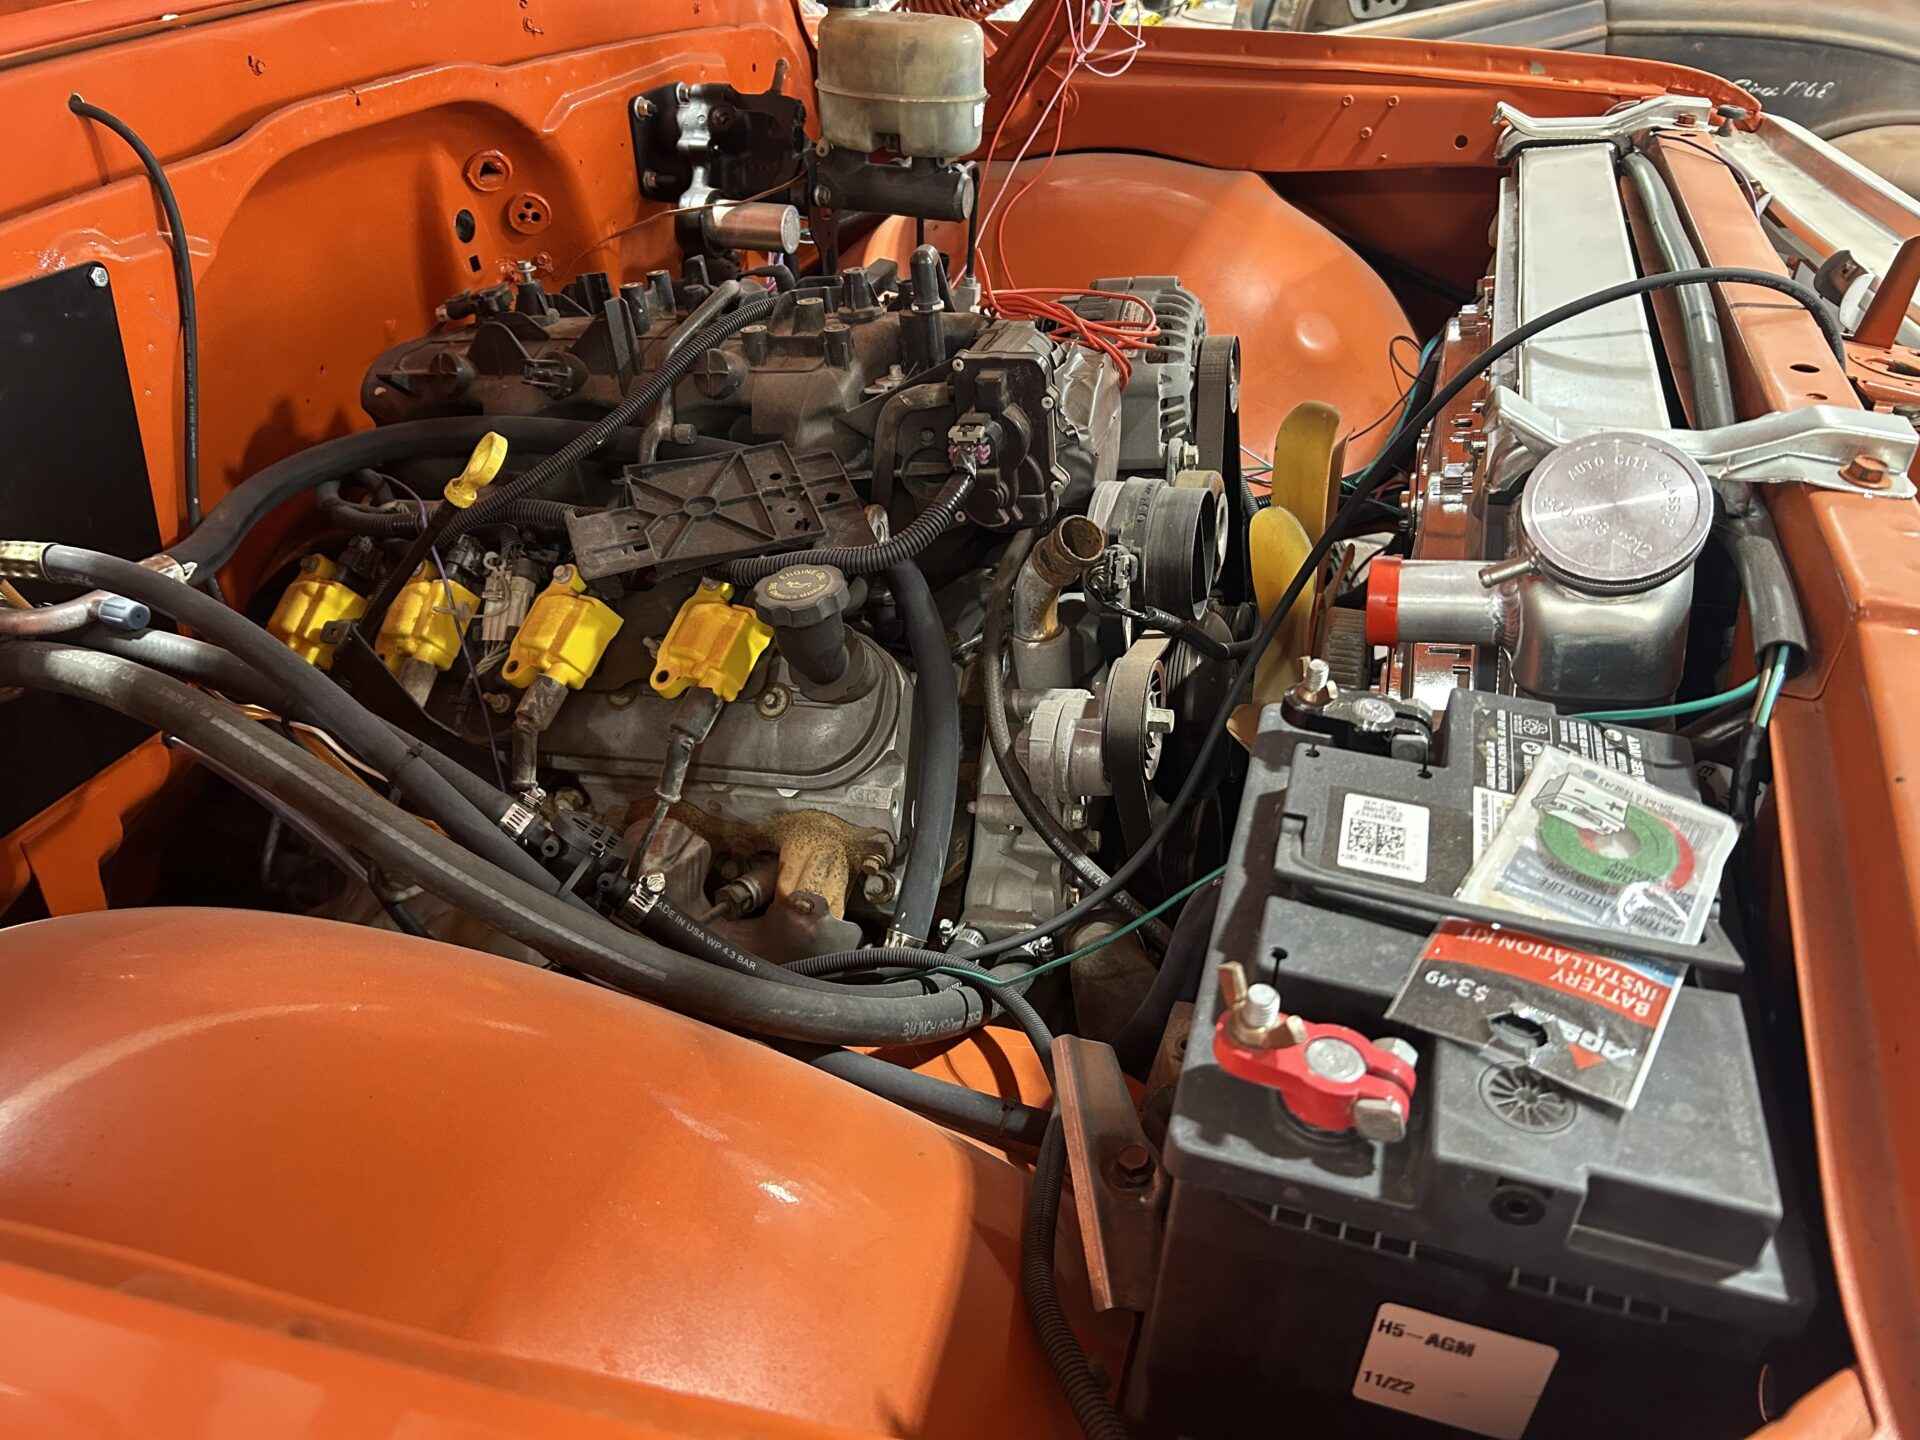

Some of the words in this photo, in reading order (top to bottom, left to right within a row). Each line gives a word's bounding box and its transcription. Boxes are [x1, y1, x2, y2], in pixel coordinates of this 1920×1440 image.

[1567, 455, 1605, 481] AUTO
[655, 900, 676, 919] ADE
[675, 916, 686, 928] IN
[686, 923, 705, 941] USA
[706, 936, 722, 950] WP
[736, 954, 757, 971] BAR
[1455, 926, 1500, 945] KIT
[1424, 969, 1491, 1002] $3.49
[1498, 938, 1659, 1000] INSTALLATION
[1550, 966, 1651, 1017] BATTERY
[1362, 1370, 1416, 1395] 11/22
